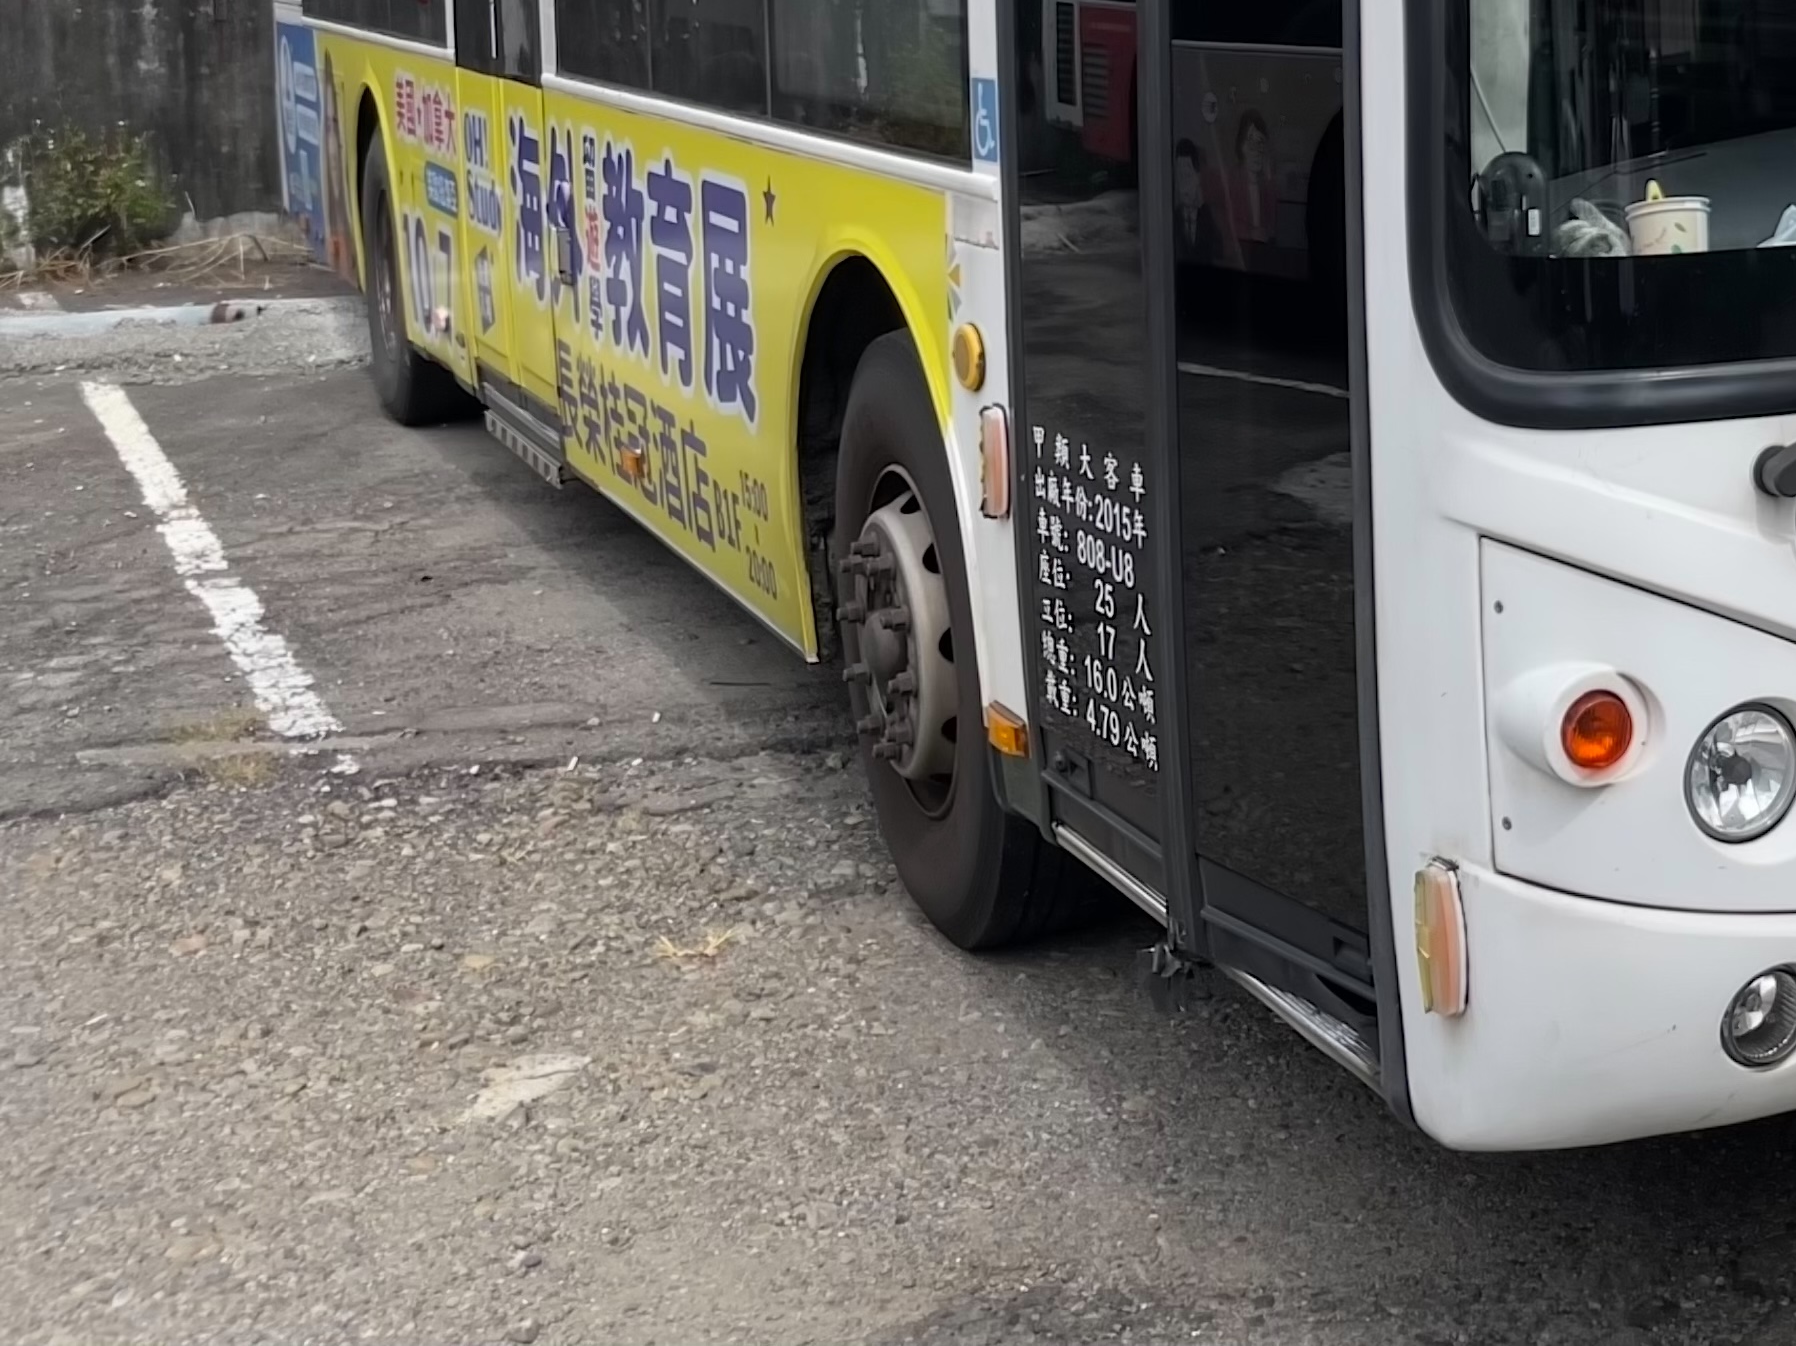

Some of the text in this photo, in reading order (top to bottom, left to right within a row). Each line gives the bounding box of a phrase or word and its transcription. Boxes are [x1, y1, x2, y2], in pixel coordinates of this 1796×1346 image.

[1076, 529, 1135, 589] 808-U8
[1094, 578, 1115, 619] 25
[1133, 593, 1152, 636] 人
[1084, 654, 1118, 702] 16.0
[1097, 621, 1116, 661] 17
[1135, 637, 1154, 682] 人
[1085, 697, 1120, 746] 4.79
